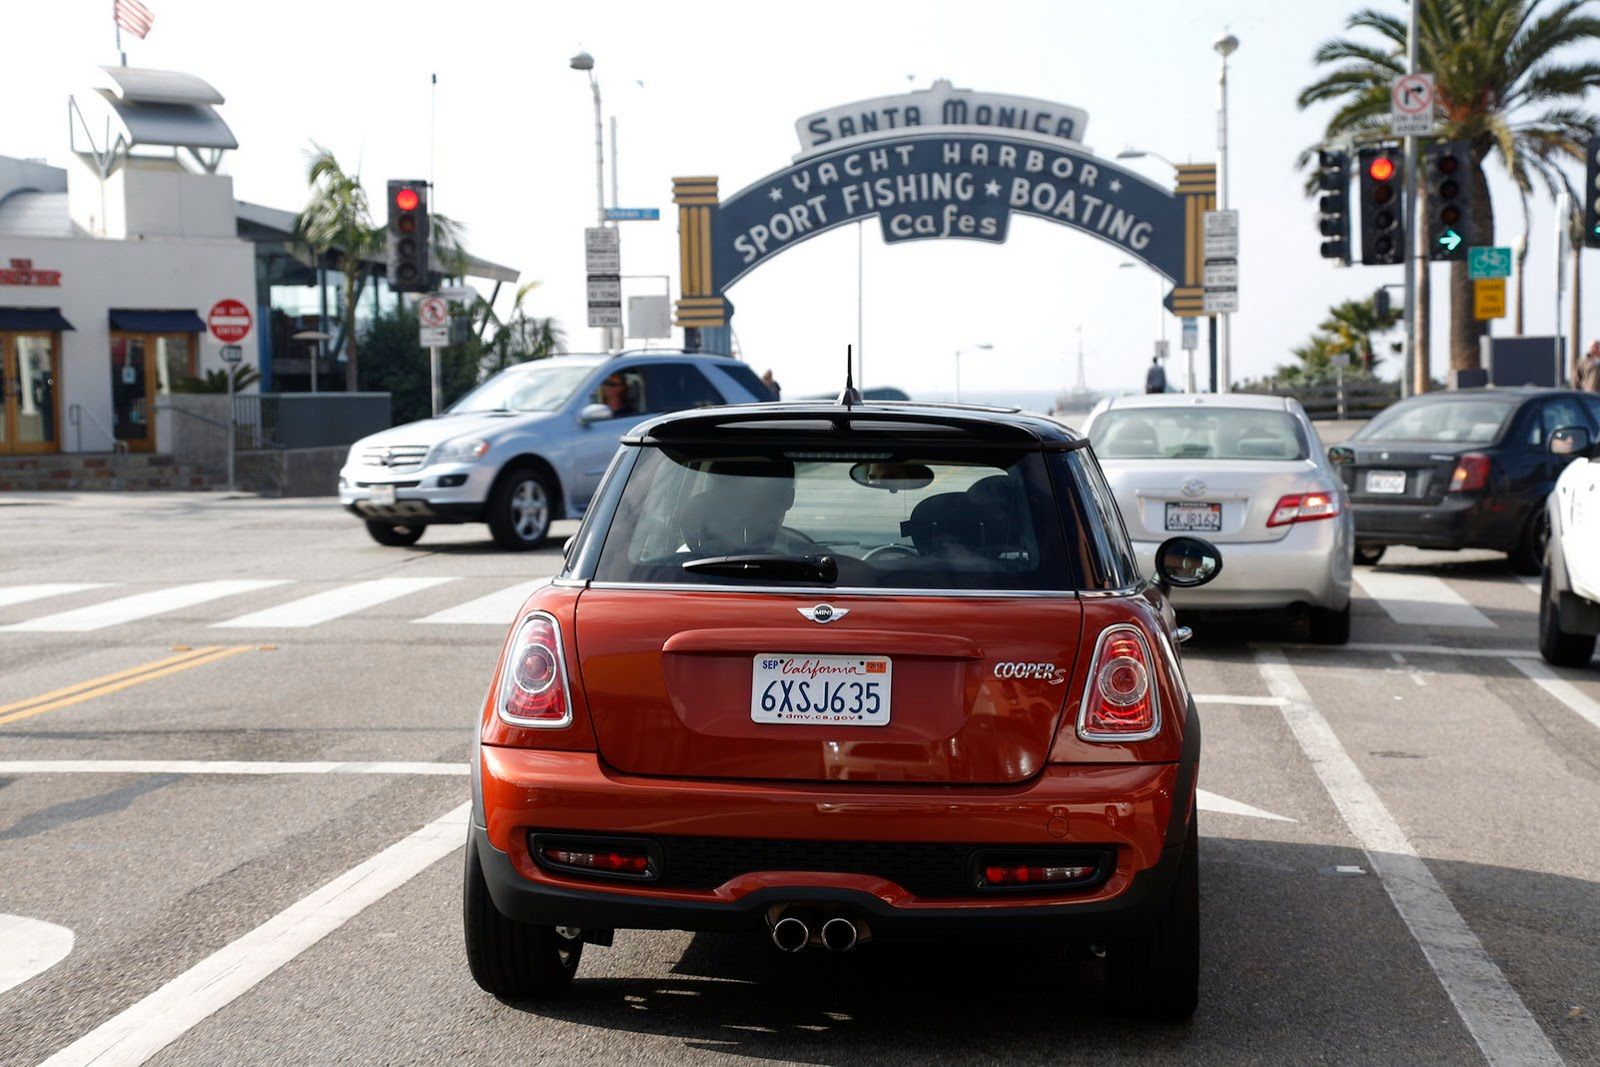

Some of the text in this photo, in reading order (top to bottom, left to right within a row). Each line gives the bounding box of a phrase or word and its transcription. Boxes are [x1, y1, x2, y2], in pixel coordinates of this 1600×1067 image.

[808, 99, 1075, 146] SANTA MONICA
[791, 143, 1099, 193] YACHT HARBOR
[734, 172, 1153, 263] SPORT FISHING BOATING
[216, 327, 243, 336] ENTER
[1169, 512, 1218, 528] 6KJR162
[815, 609, 833, 617] MINI
[762, 660, 778, 669] SEP
[782, 658, 865, 679] California
[994, 662, 1067, 685] COOPER S
[761, 680, 880, 714] 6XSJ635
